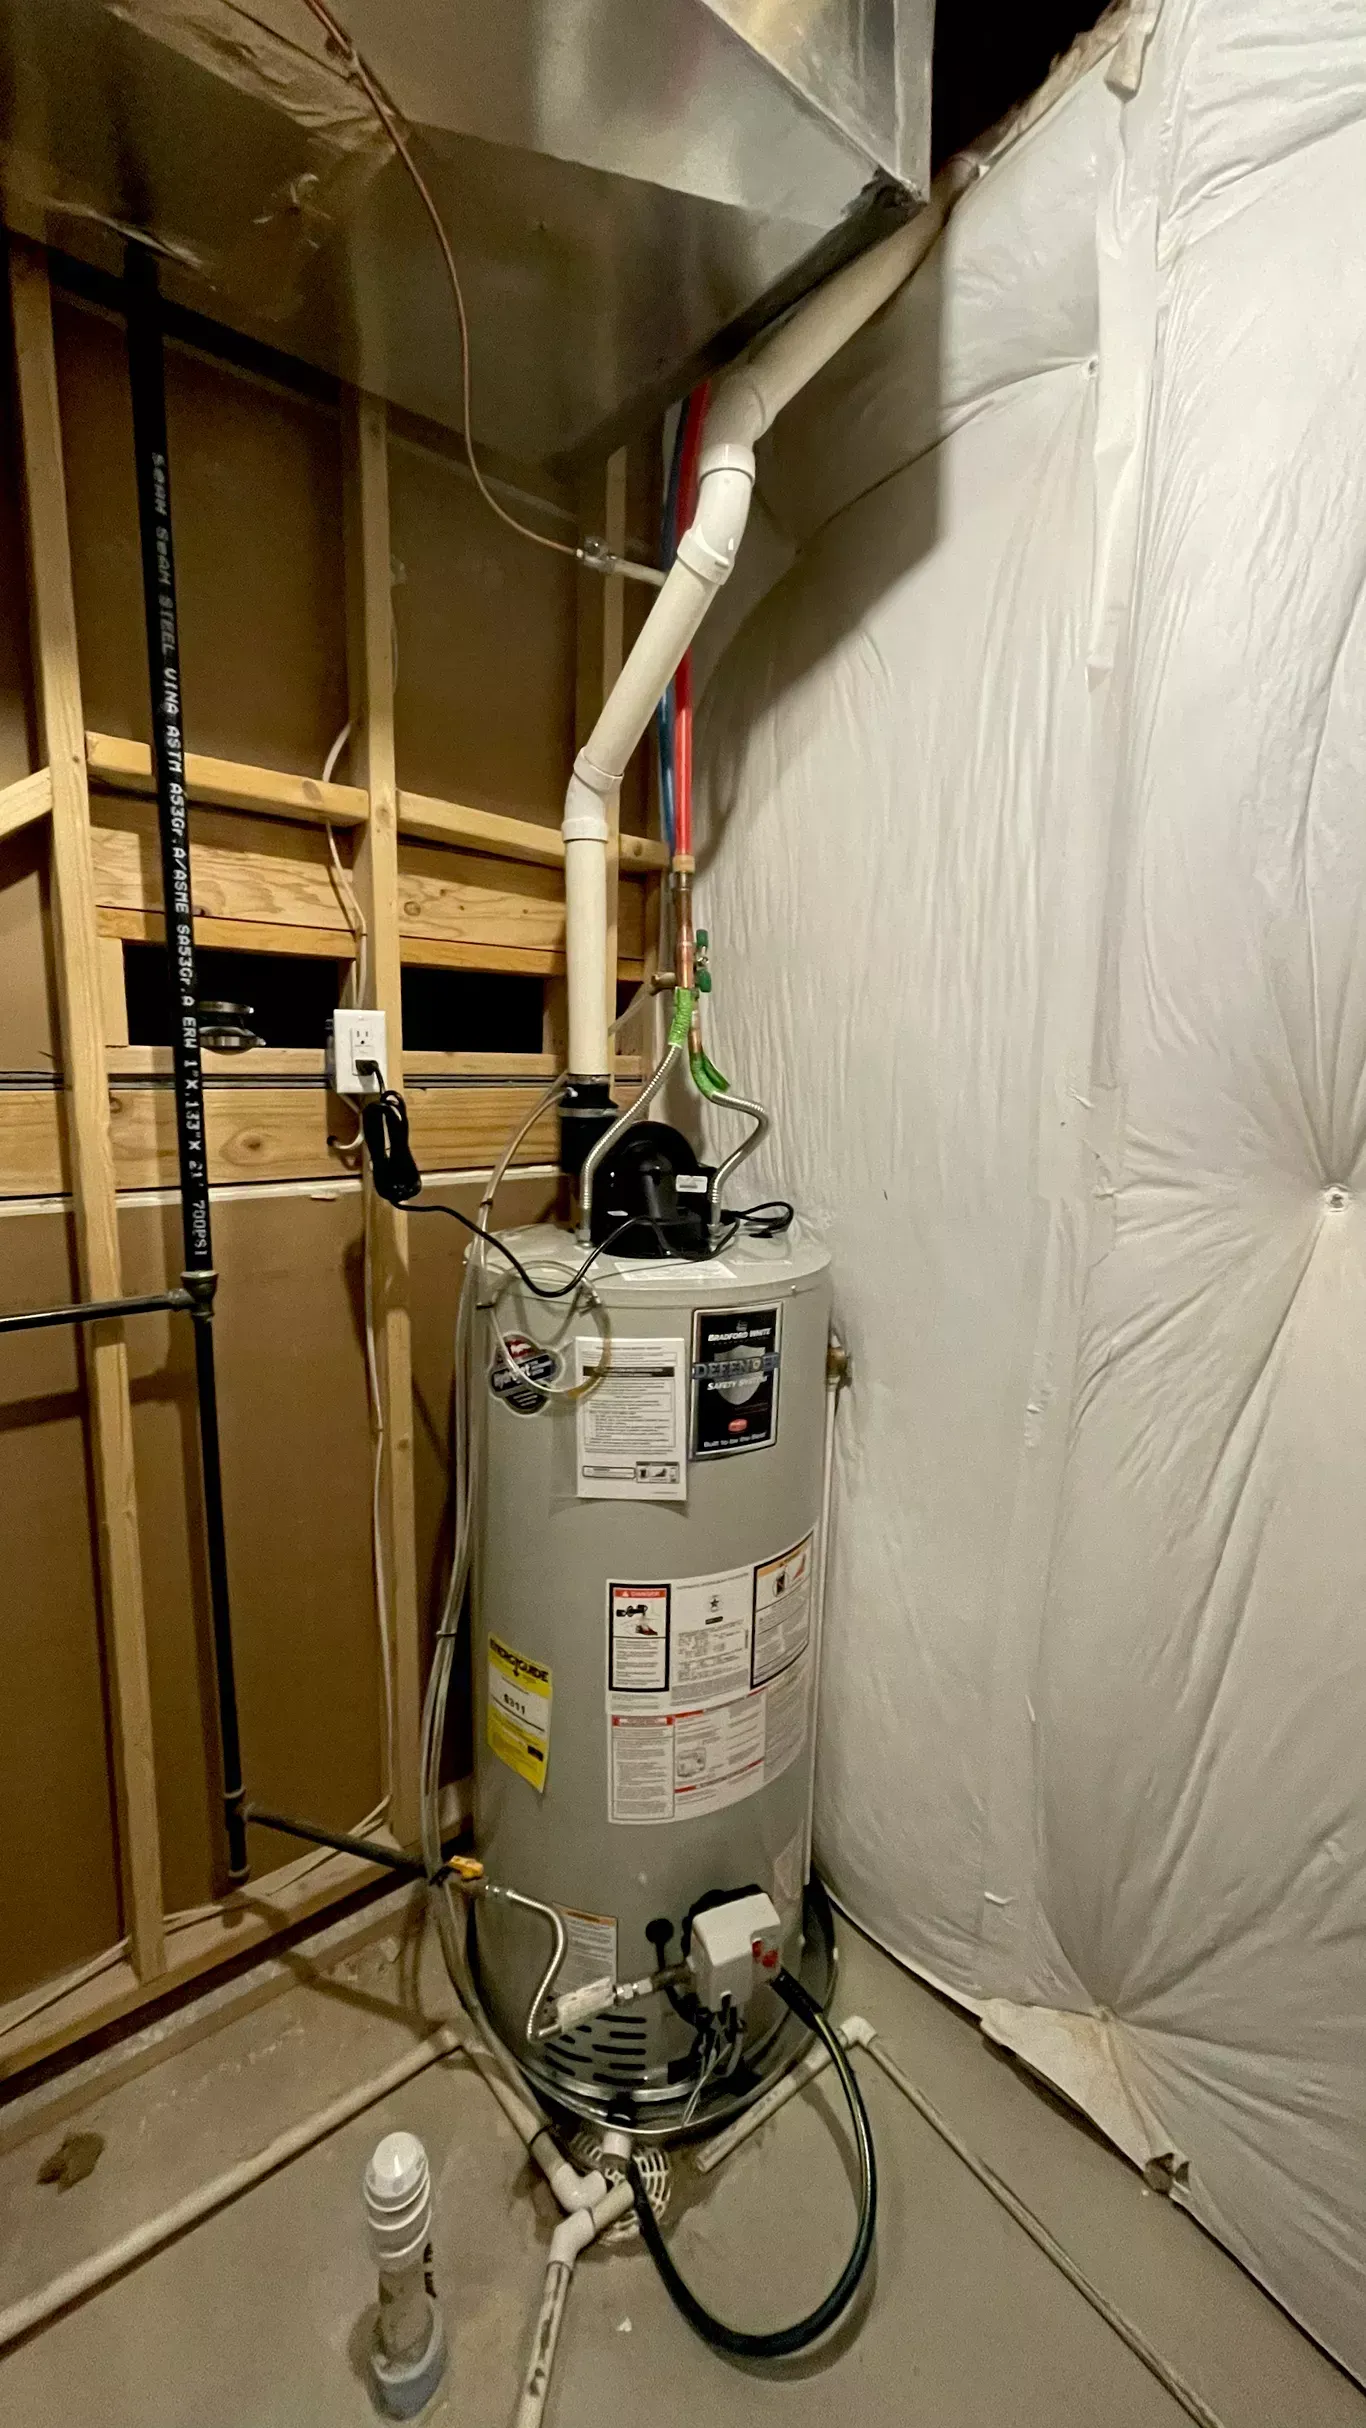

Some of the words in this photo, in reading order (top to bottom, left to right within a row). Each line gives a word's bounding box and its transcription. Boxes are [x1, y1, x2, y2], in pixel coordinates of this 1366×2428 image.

[163, 667, 179, 714] VINA
[166, 725, 182, 773] ASTM
[176, 924, 195, 1006] SA53Gr.A
[182, 1017, 198, 1049] ERW
[192, 1200, 208, 1255] 700PSI
